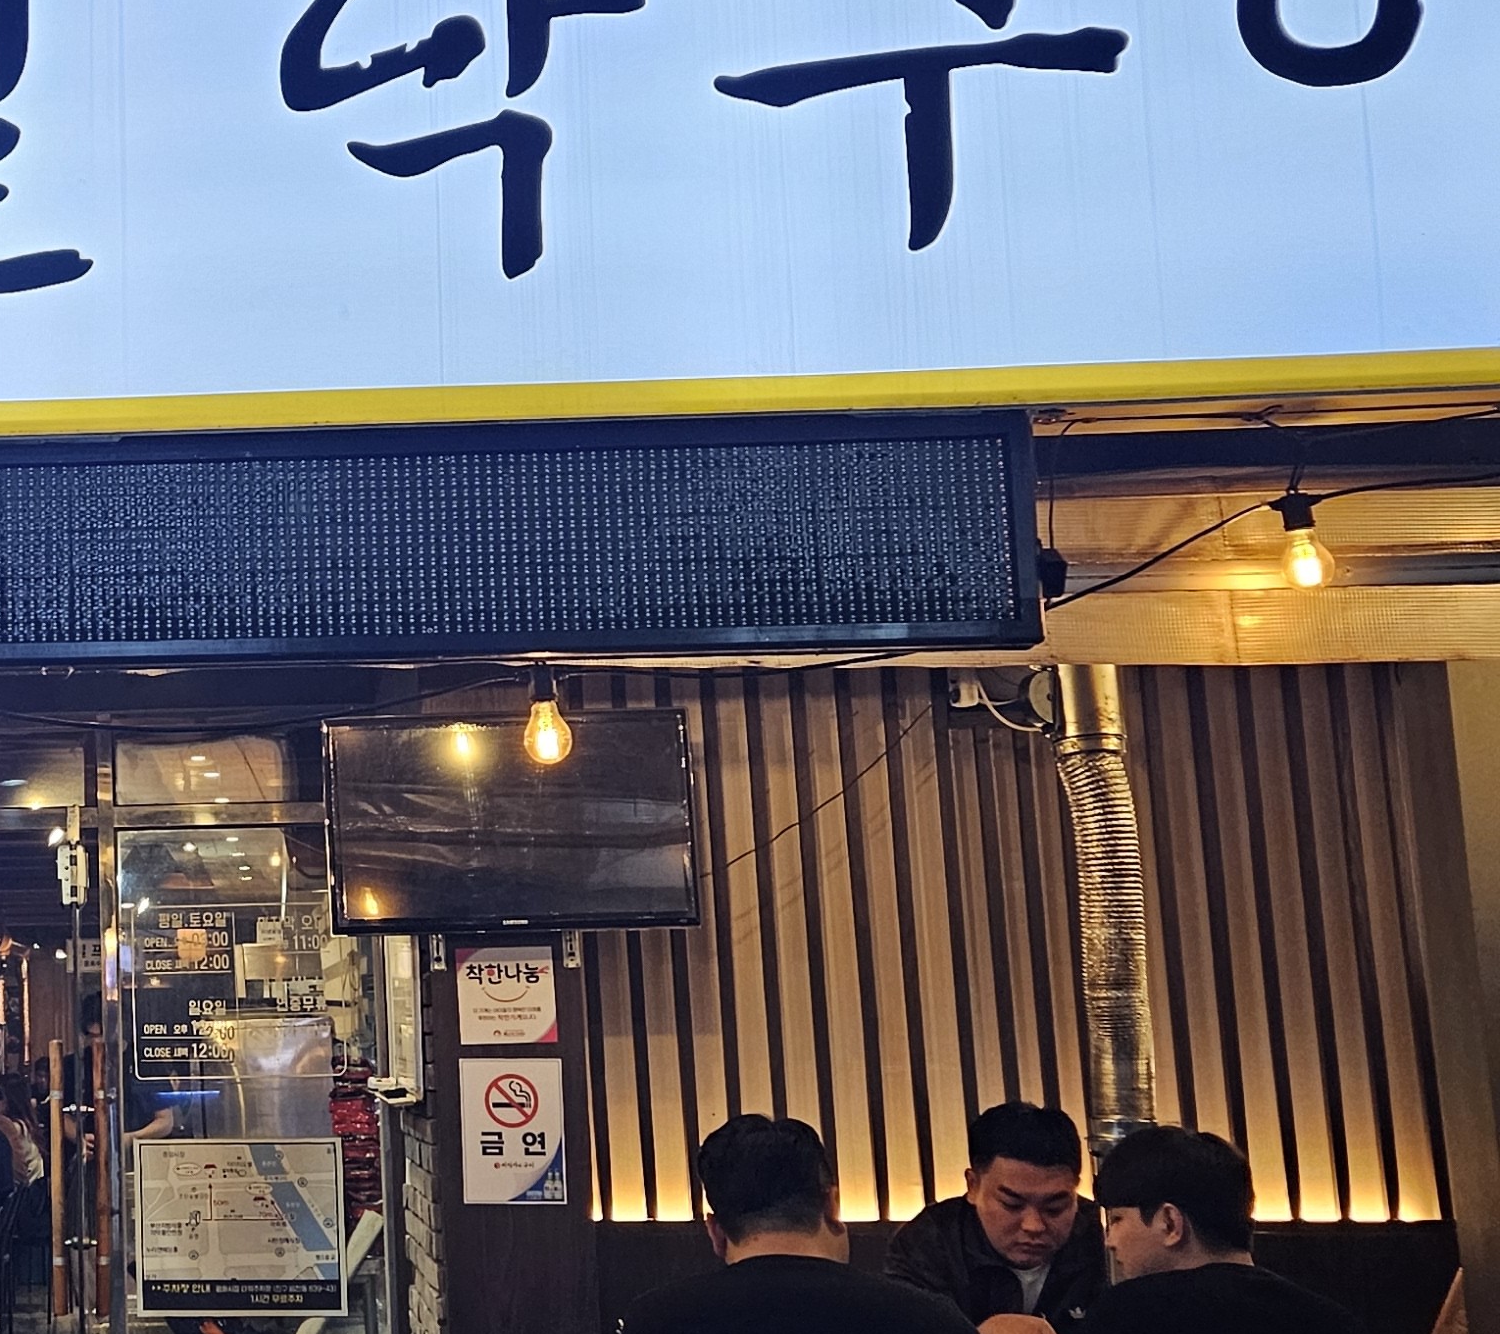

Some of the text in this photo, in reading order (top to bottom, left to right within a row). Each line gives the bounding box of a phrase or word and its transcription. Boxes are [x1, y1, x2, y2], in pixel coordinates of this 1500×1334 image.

[144, 937, 168, 947] OPEN
[145, 959, 172, 970] CLOSE
[194, 954, 229, 969] 12:00
[466, 963, 540, 986] 착한나눔
[188, 1000, 227, 1016] 일요일
[143, 1023, 167, 1035] OPEN
[144, 1047, 171, 1058] CLOSE
[480, 1131, 547, 1156] 금연
